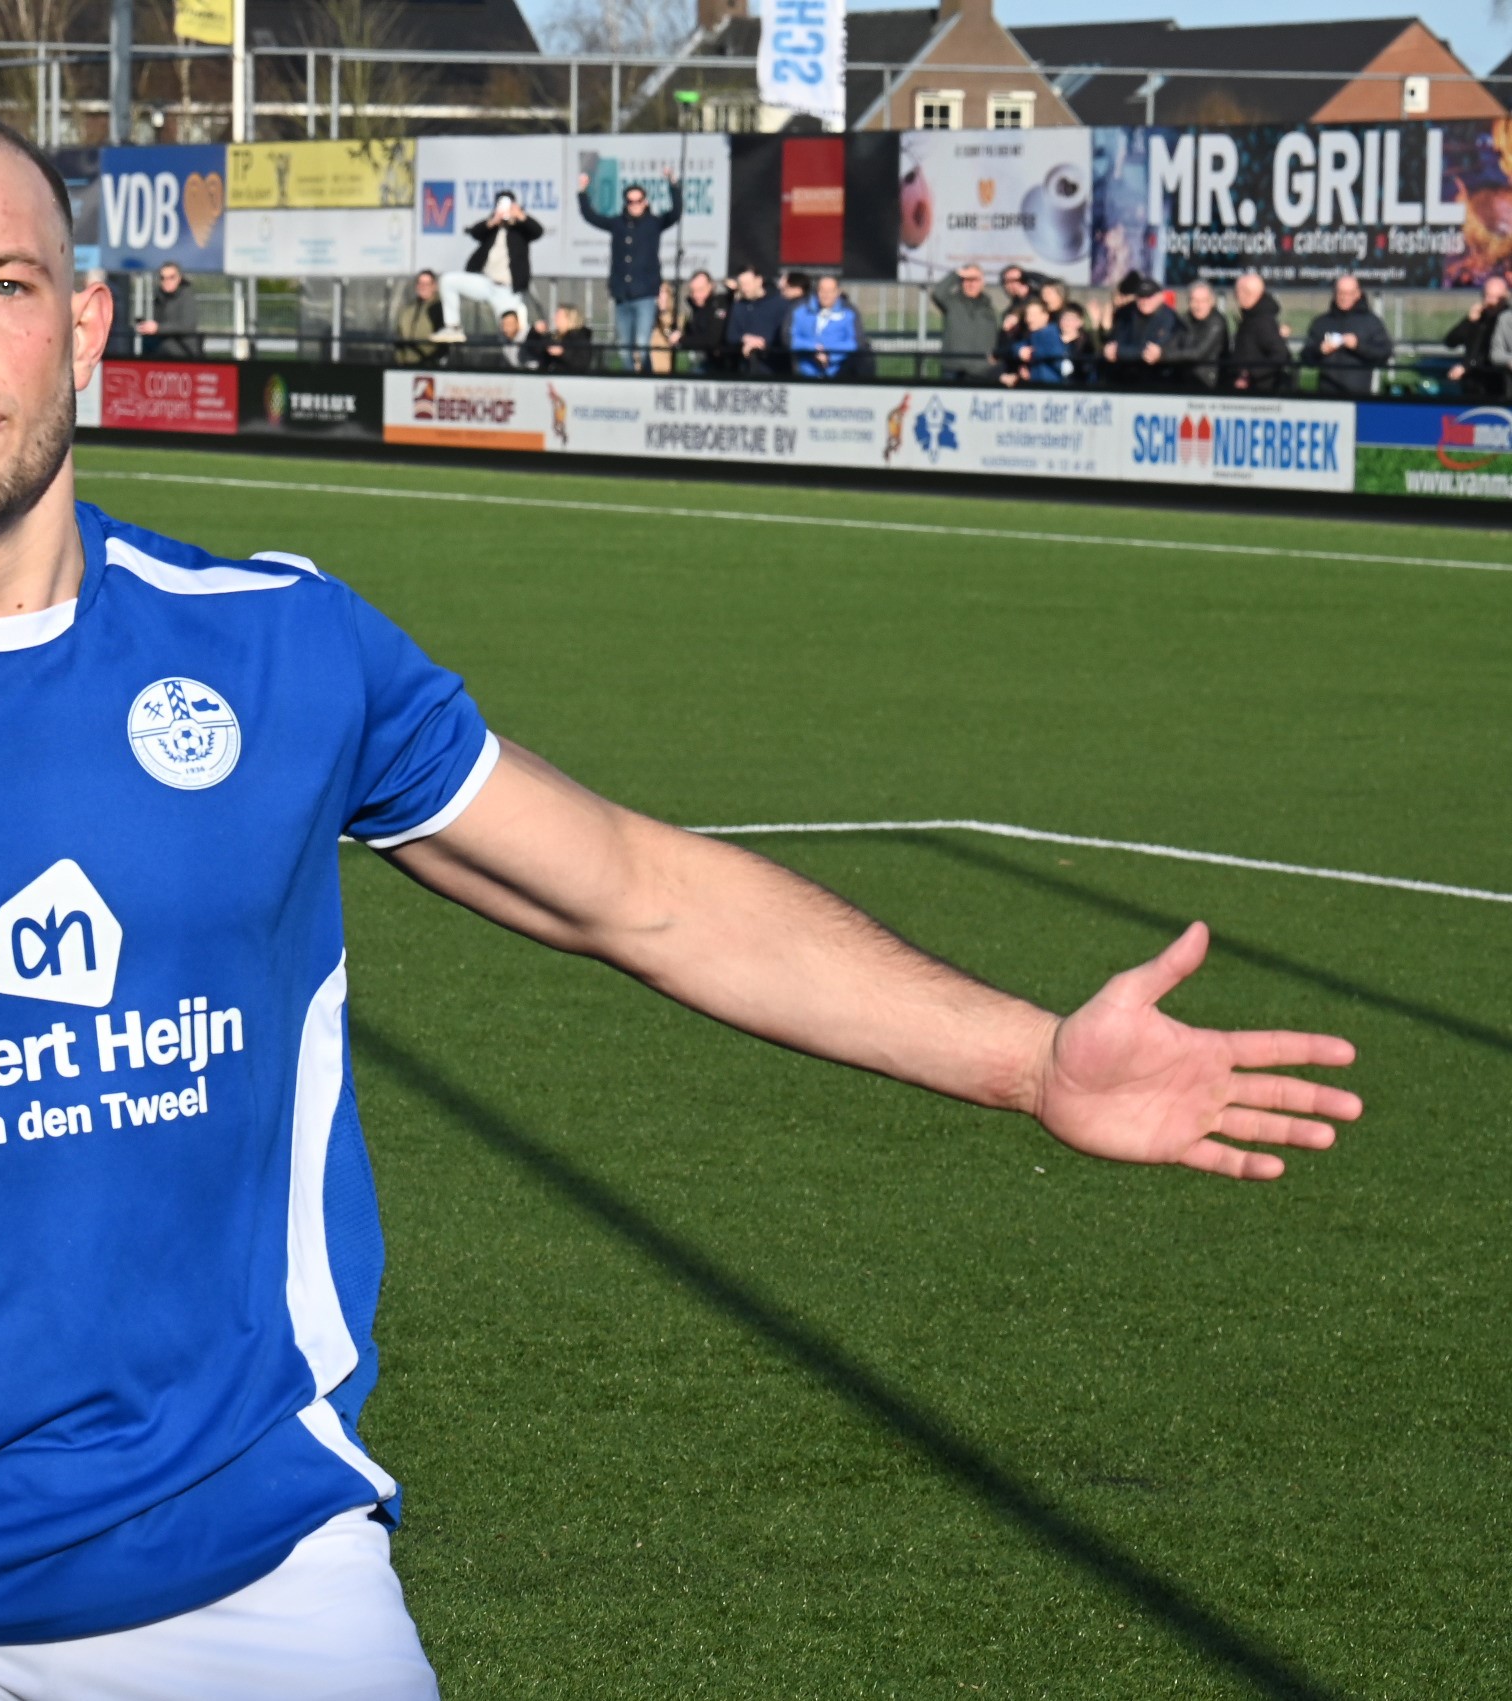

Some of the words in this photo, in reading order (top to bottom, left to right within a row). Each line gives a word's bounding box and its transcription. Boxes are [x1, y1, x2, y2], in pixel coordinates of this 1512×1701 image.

[1148, 132, 1258, 227] MR.
[1272, 129, 1467, 227] GRILL
[100, 172, 180, 249] VDB
[1192, 228, 1277, 254] foodtruck
[1293, 229, 1367, 260] catering
[1388, 228, 1466, 255] festivals
[290, 392, 356, 412] TRILUX
[436, 397, 517, 424] BERKHOF
[654, 384, 687, 412] HET
[693, 384, 790, 417] NIJKERKSE
[969, 395, 1004, 422] Aart
[1008, 401, 1037, 424] van
[1041, 397, 1069, 425] der
[774, 425, 798, 455] BV
[95, 996, 244, 1072] Heijn
[18, 1100, 93, 1141] den
[100, 1075, 208, 1130] Tweel
